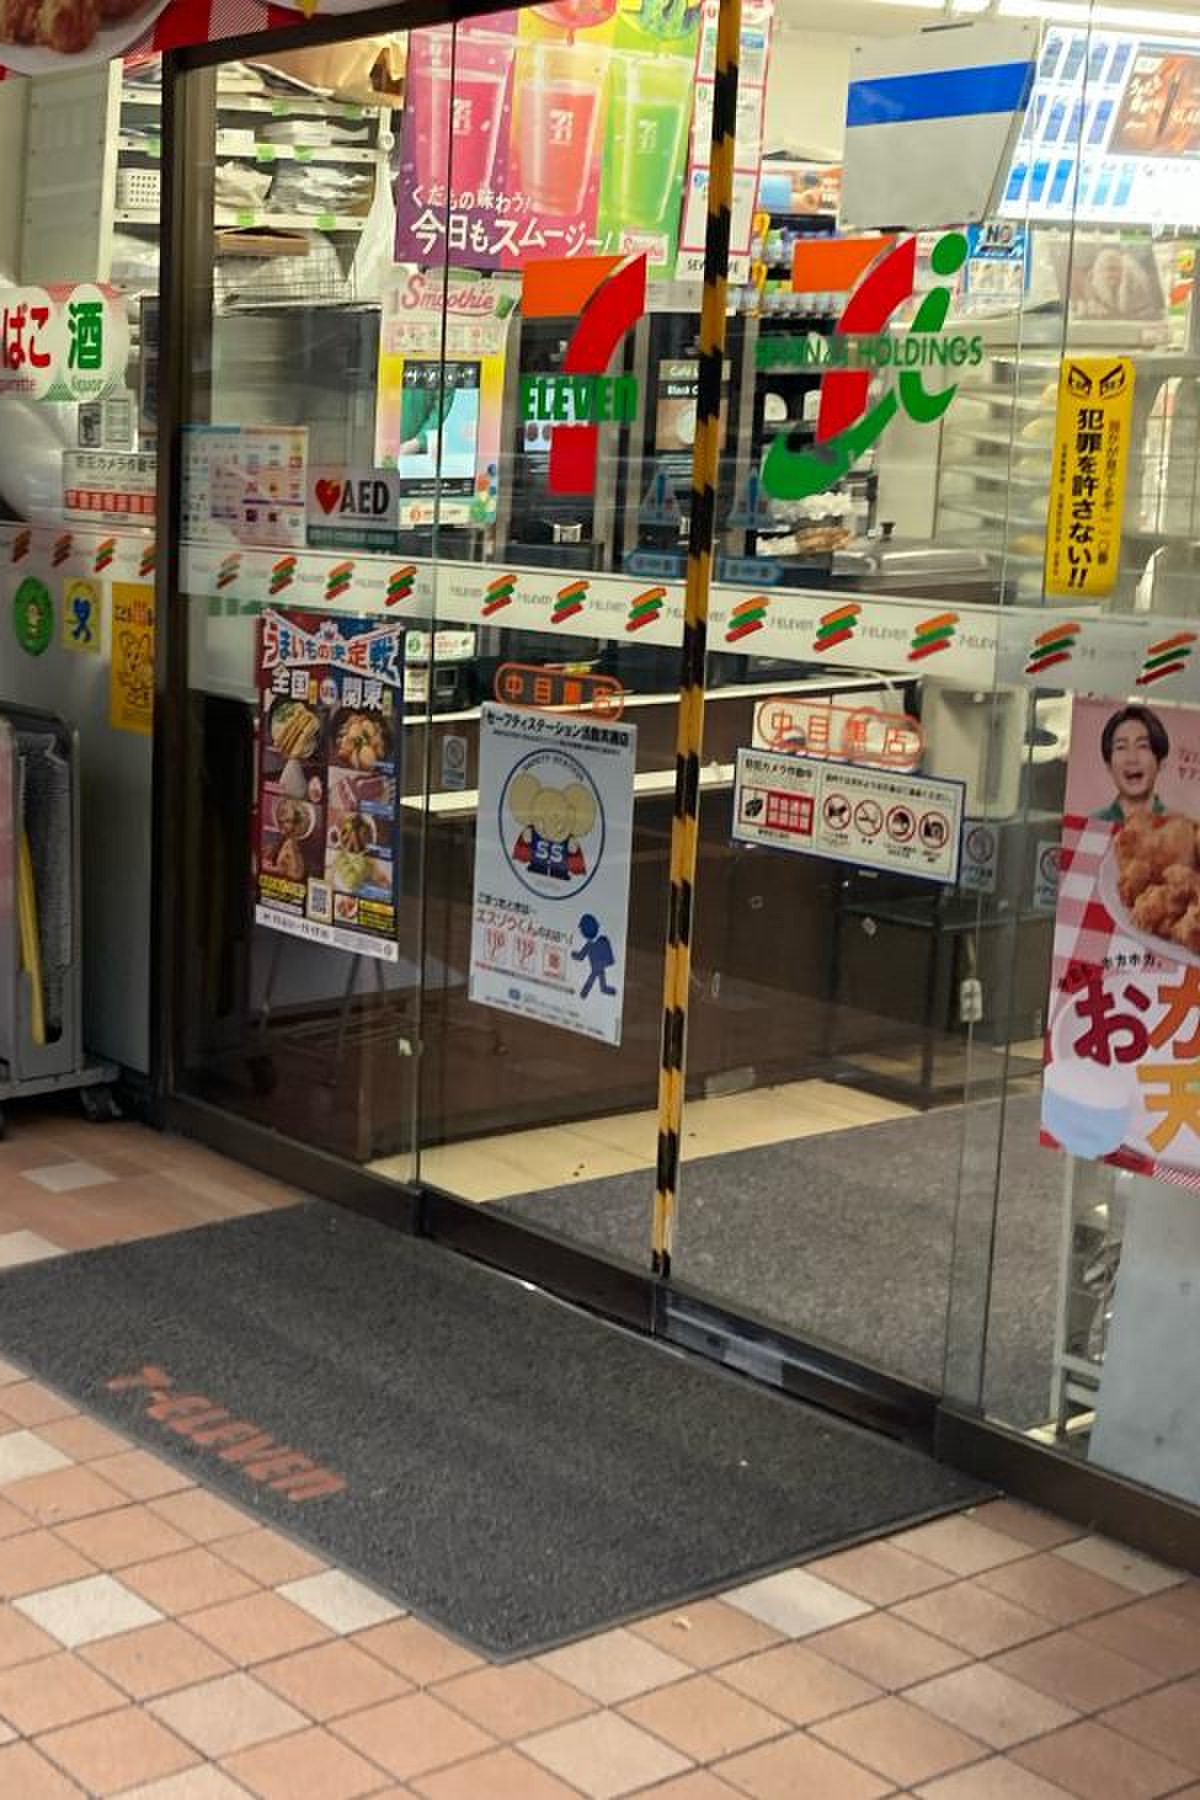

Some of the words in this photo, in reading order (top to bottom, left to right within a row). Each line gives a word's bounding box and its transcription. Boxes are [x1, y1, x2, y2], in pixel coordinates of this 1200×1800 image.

[67, 302, 103, 369] 酒
[339, 480, 391, 515] AED
[1067, 407, 1105, 588] 犯罪を許さない!!
